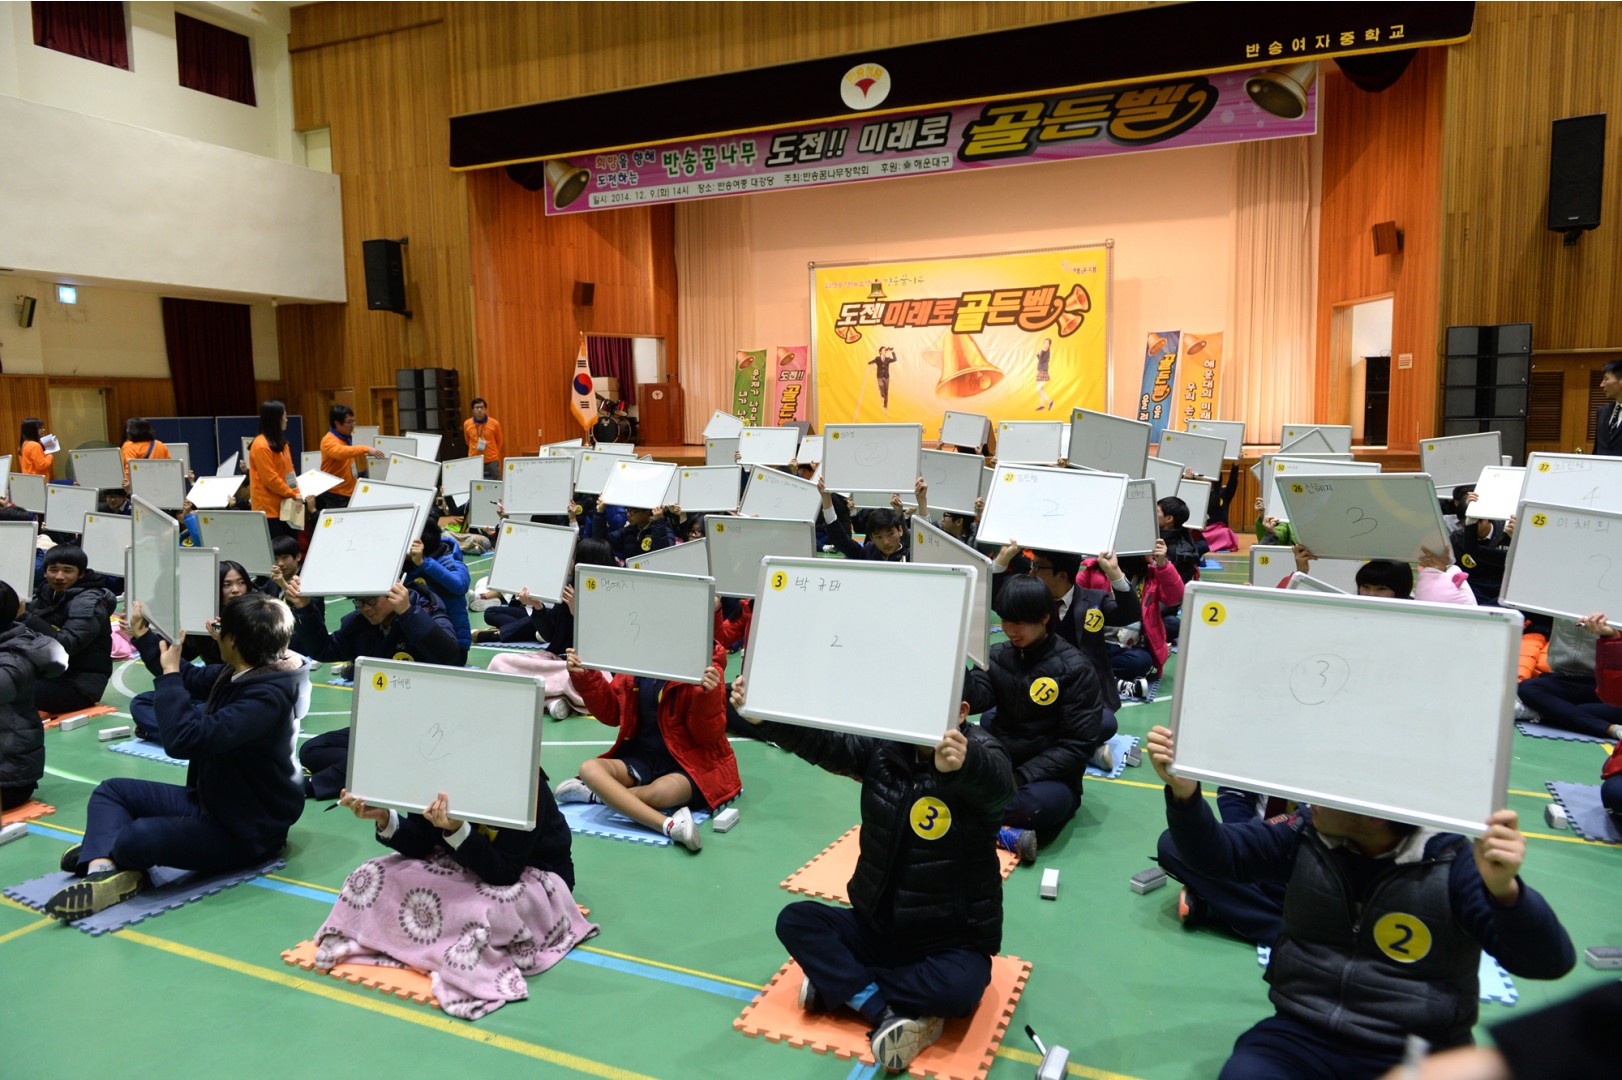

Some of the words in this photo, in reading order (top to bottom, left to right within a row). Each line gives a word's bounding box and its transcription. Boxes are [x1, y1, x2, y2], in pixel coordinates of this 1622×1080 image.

[1246, 24, 1404, 58] 반송여자중학교
[957, 75, 1220, 162] 골든벨
[765, 127, 849, 168] 도전!!
[857, 111, 952, 153] 미래로
[633, 150, 656, 167] 향해
[661, 141, 757, 177] 반송꿈나무
[913, 155, 950, 170] 해운대구
[597, 171, 639, 187] 도전하는
[717, 179, 748, 191] 반송여중
[750, 174, 775, 187] 대강당
[611, 192, 631, 203] 2014.
[673, 185, 689, 196] 14시
[836, 301, 885, 326] 도전!
[882, 299, 957, 328] 미래로
[951, 284, 1065, 334] 골든벨
[779, 370, 806, 381] 도전!!
[1151, 353, 1177, 403] 골든벨
[1202, 359, 1216, 398] 해운대의
[1185, 382, 1197, 401] 우리
[1539, 463, 1550, 471] 37
[1004, 473, 1014, 481] 27
[1292, 484, 1303, 493] 26
[1042, 499, 1065, 517] 2
[1346, 507, 1378, 539] 3
[1534, 515, 1545, 526] 25
[1260, 555, 1269, 565] 38
[587, 580, 596, 590] 16
[775, 575, 783, 588] 3
[1085, 612, 1102, 628] 27
[1209, 606, 1219, 622] 2
[628, 611, 641, 642] 3
[830, 635, 843, 648] 2
[376, 676, 383, 688] 4
[1317, 660, 1330, 688] 3
[1035, 682, 1055, 702] 15
[428, 722, 444, 757] 3
[918, 806, 939, 831] 3
[1389, 923, 1413, 955] 2
